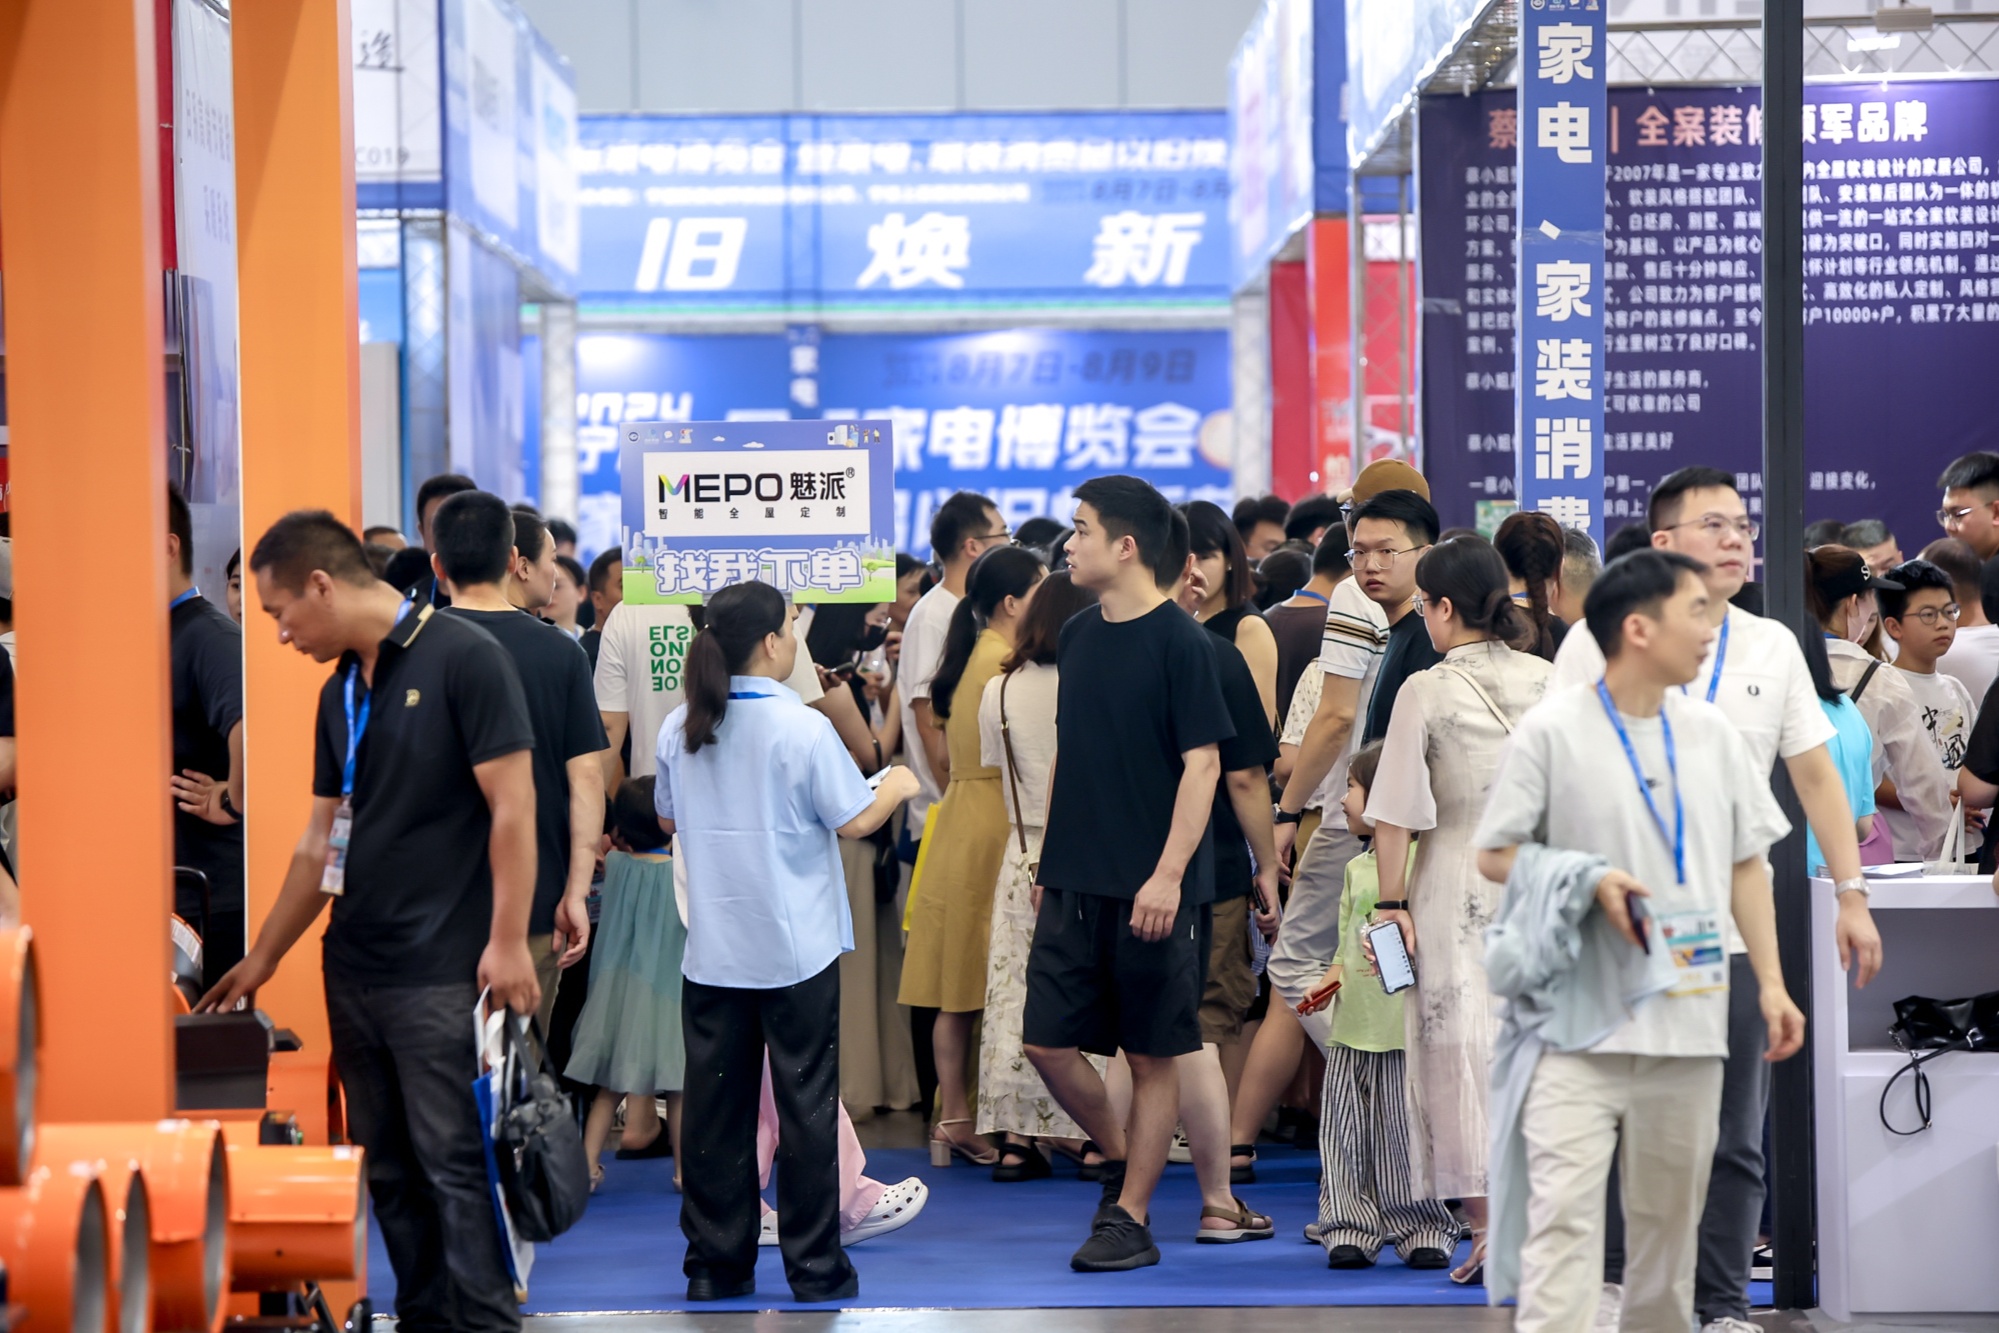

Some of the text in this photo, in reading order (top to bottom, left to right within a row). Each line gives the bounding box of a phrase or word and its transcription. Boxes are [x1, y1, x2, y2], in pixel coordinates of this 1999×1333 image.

[658, 473, 783, 503] MEPO
[658, 506, 846, 520] 智能全屋定制
